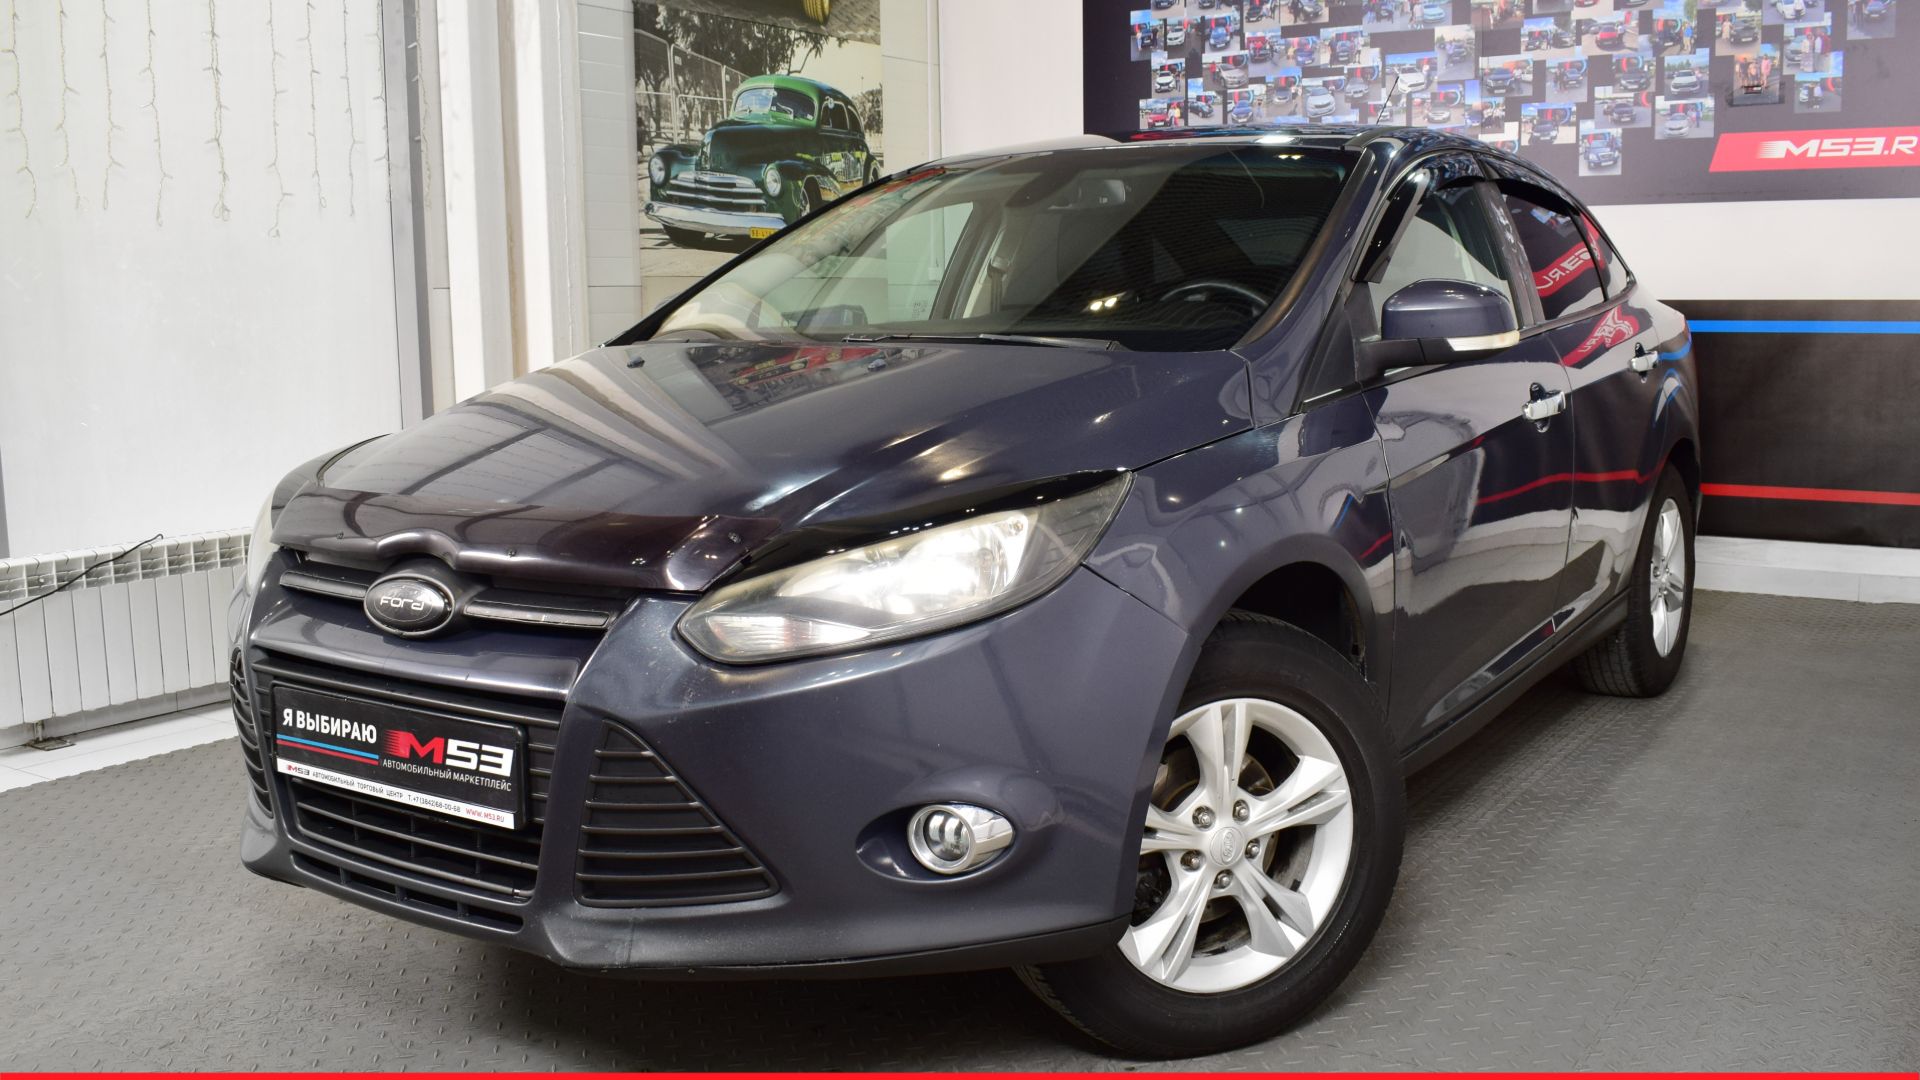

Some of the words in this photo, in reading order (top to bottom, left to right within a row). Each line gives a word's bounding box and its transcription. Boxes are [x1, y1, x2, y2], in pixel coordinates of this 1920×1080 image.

[282, 708, 293, 727] Я
[296, 710, 377, 744] ВЫБИРАЮ
[384, 729, 514, 777] M53
[312, 771, 355, 786] АВТОМОБИЛЬНЫЙ
[357, 781, 384, 794] ТОРГОВЫЙ
[382, 758, 452, 780] АВТОМОБИЛЬНЫЙ
[452, 774, 512, 792] МАРКЕТПЛЕЙС
